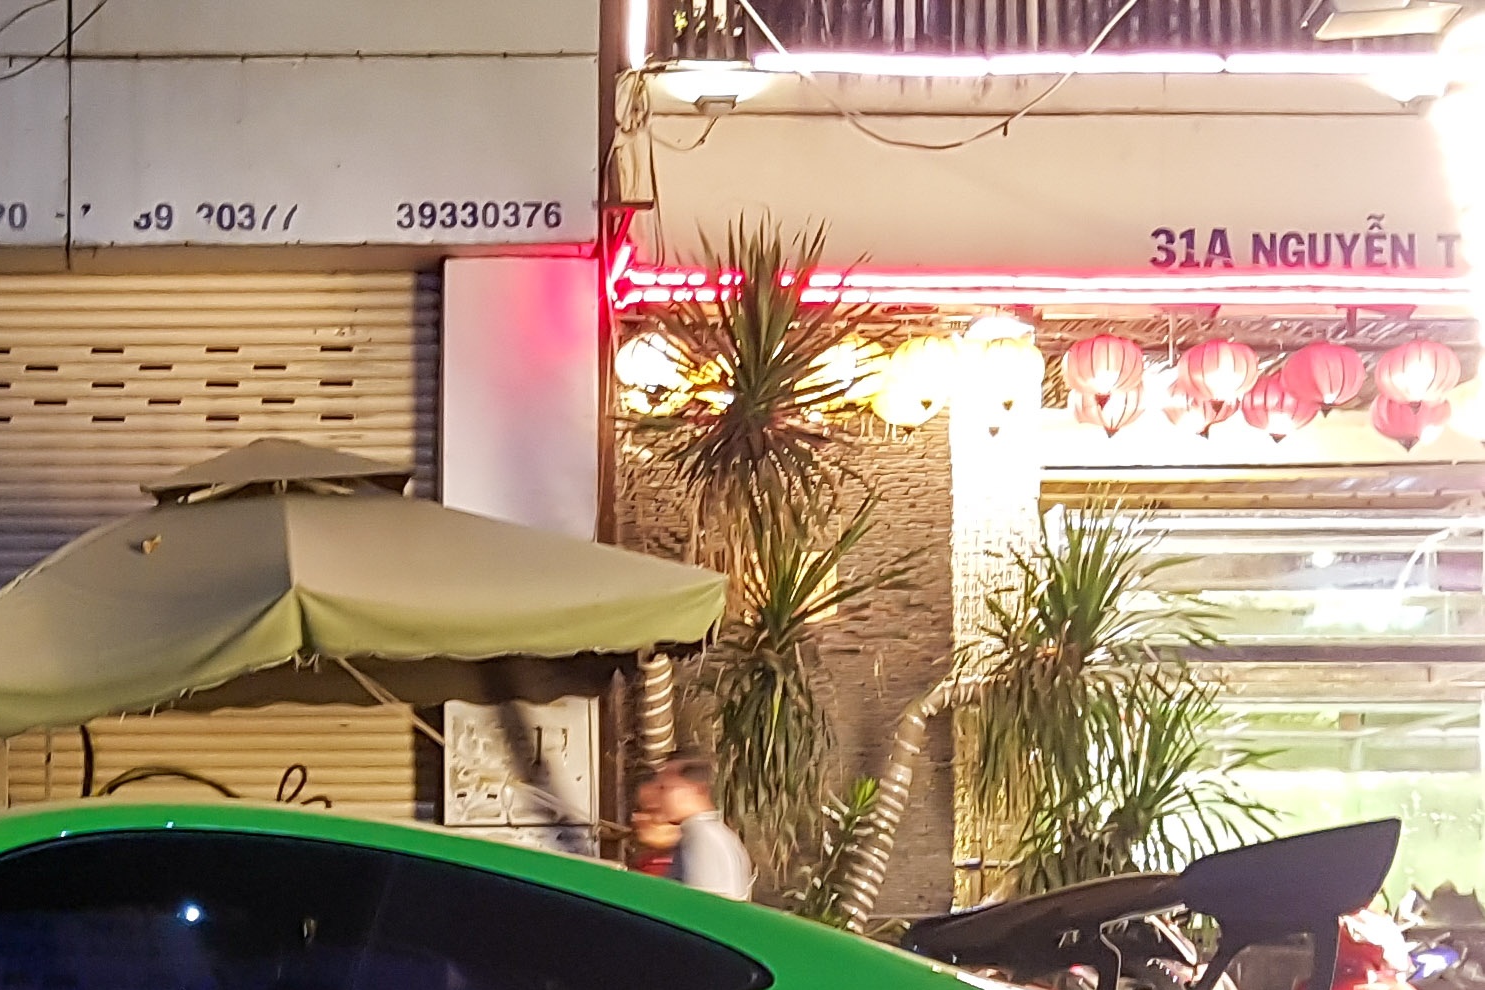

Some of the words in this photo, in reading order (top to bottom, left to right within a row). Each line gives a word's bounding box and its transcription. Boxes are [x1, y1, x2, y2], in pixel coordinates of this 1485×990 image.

[396, 201, 563, 229] 39330376
[1148, 226, 1235, 269] 31A
[1251, 212, 1417, 269] NGUYỄN
